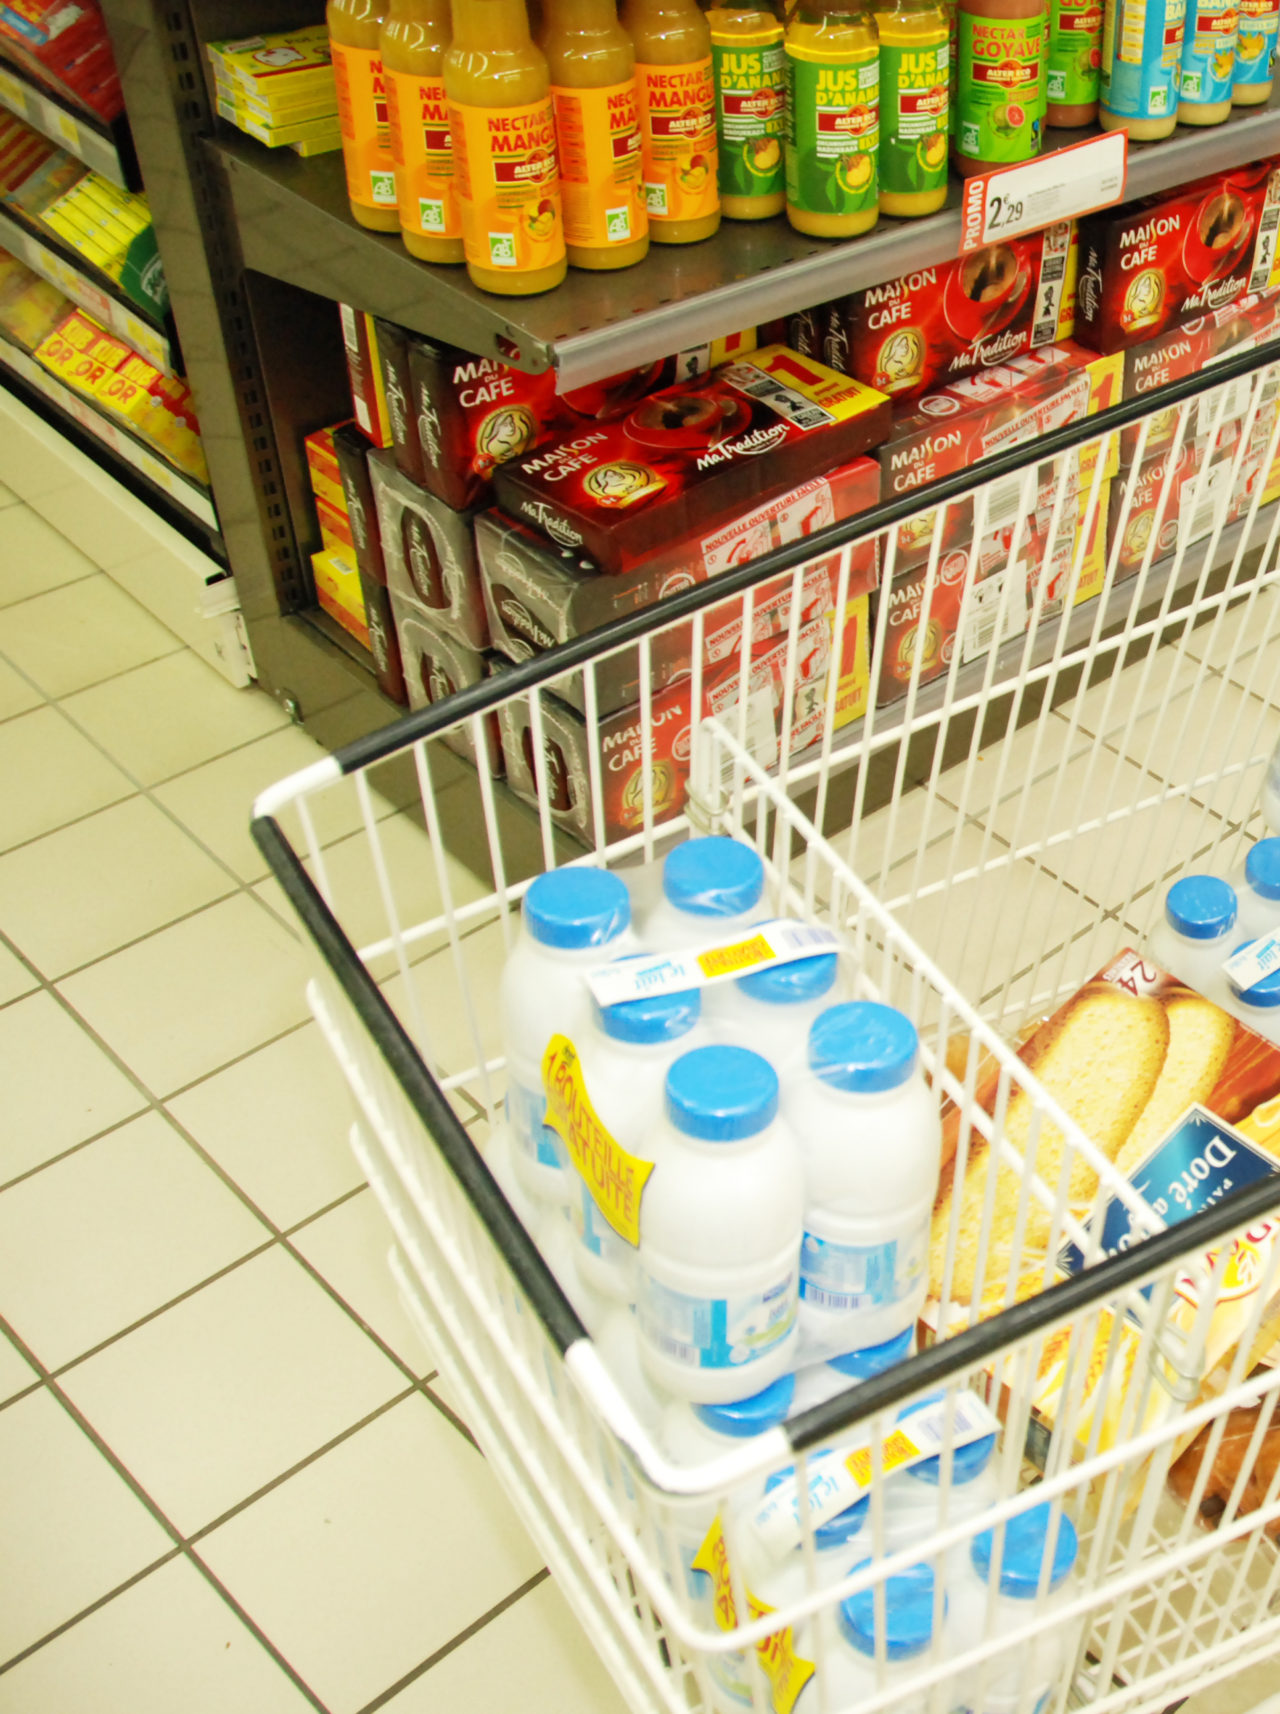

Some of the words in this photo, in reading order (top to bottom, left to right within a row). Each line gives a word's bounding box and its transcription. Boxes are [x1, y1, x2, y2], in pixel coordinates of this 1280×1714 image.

[972, 23, 1026, 40] NECTAR
[972, 36, 1041, 59] GOYAVE
[720, 53, 762, 75] JUS
[897, 51, 937, 74] JUS
[986, 68, 1014, 77] ALTER
[1015, 67, 1031, 76] ECO
[646, 71, 703, 89] NECTAR
[815, 69, 858, 92] JUS
[487, 110, 547, 133] NECTAR
[668, 118, 697, 129] ALTER
[834, 116, 861, 127] ALTER
[962, 180, 985, 251] PROMO
[1119, 213, 1181, 249] MAISON
[864, 267, 938, 309] MAISON
[1197, 275, 1247, 310] Tradition
[47, 339, 75, 367] OR
[967, 329, 1028, 367] Tradition
[1134, 340, 1192, 374] MAISON
[75, 360, 106, 386] OR
[764, 353, 826, 387] 1
[108, 379, 138, 405] OR
[818, 386, 862, 409] GRATUIT
[521, 431, 609, 475] MAISON
[696, 449, 725, 471] Ma
[712, 423, 791, 456] Tradition
[890, 430, 962, 471] MAISON
[533, 502, 585, 549] Tradition
[704, 518, 749, 552] NOUVELLE
[748, 493, 796, 528] OUVERTURE
[1119, 959, 1158, 997] 24
[554, 1062, 636, 1190] BOUTEILLE
[1168, 1135, 1237, 1211] Doré
